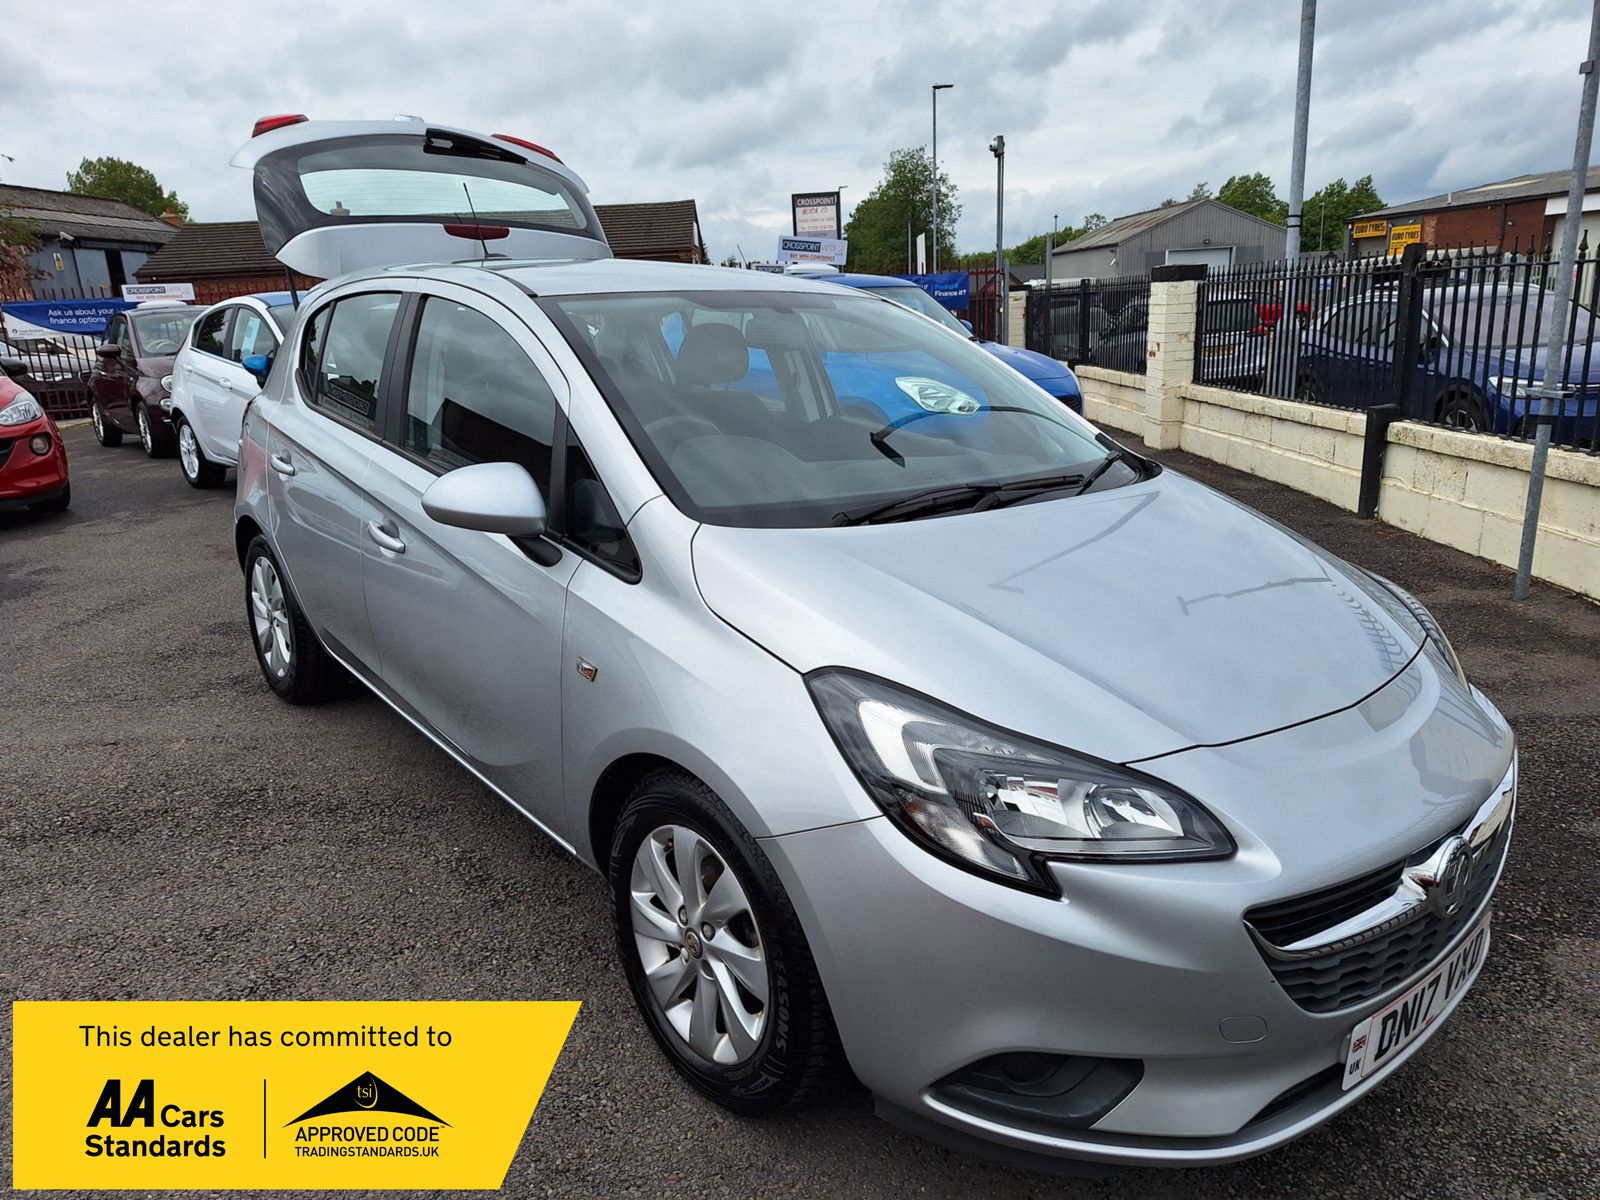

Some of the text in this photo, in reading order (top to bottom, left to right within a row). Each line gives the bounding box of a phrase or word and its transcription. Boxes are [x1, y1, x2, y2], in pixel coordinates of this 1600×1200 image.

[797, 197, 835, 206] CROSSPOINT
[1355, 225, 1368, 234] EURO
[1369, 222, 1385, 232] TYRES
[1392, 231, 1420, 241] EURO TYRES
[783, 241, 820, 253] CROSSPOINT
[1374, 972, 1442, 1062] DN17
[1349, 1058, 1362, 1075] UK
